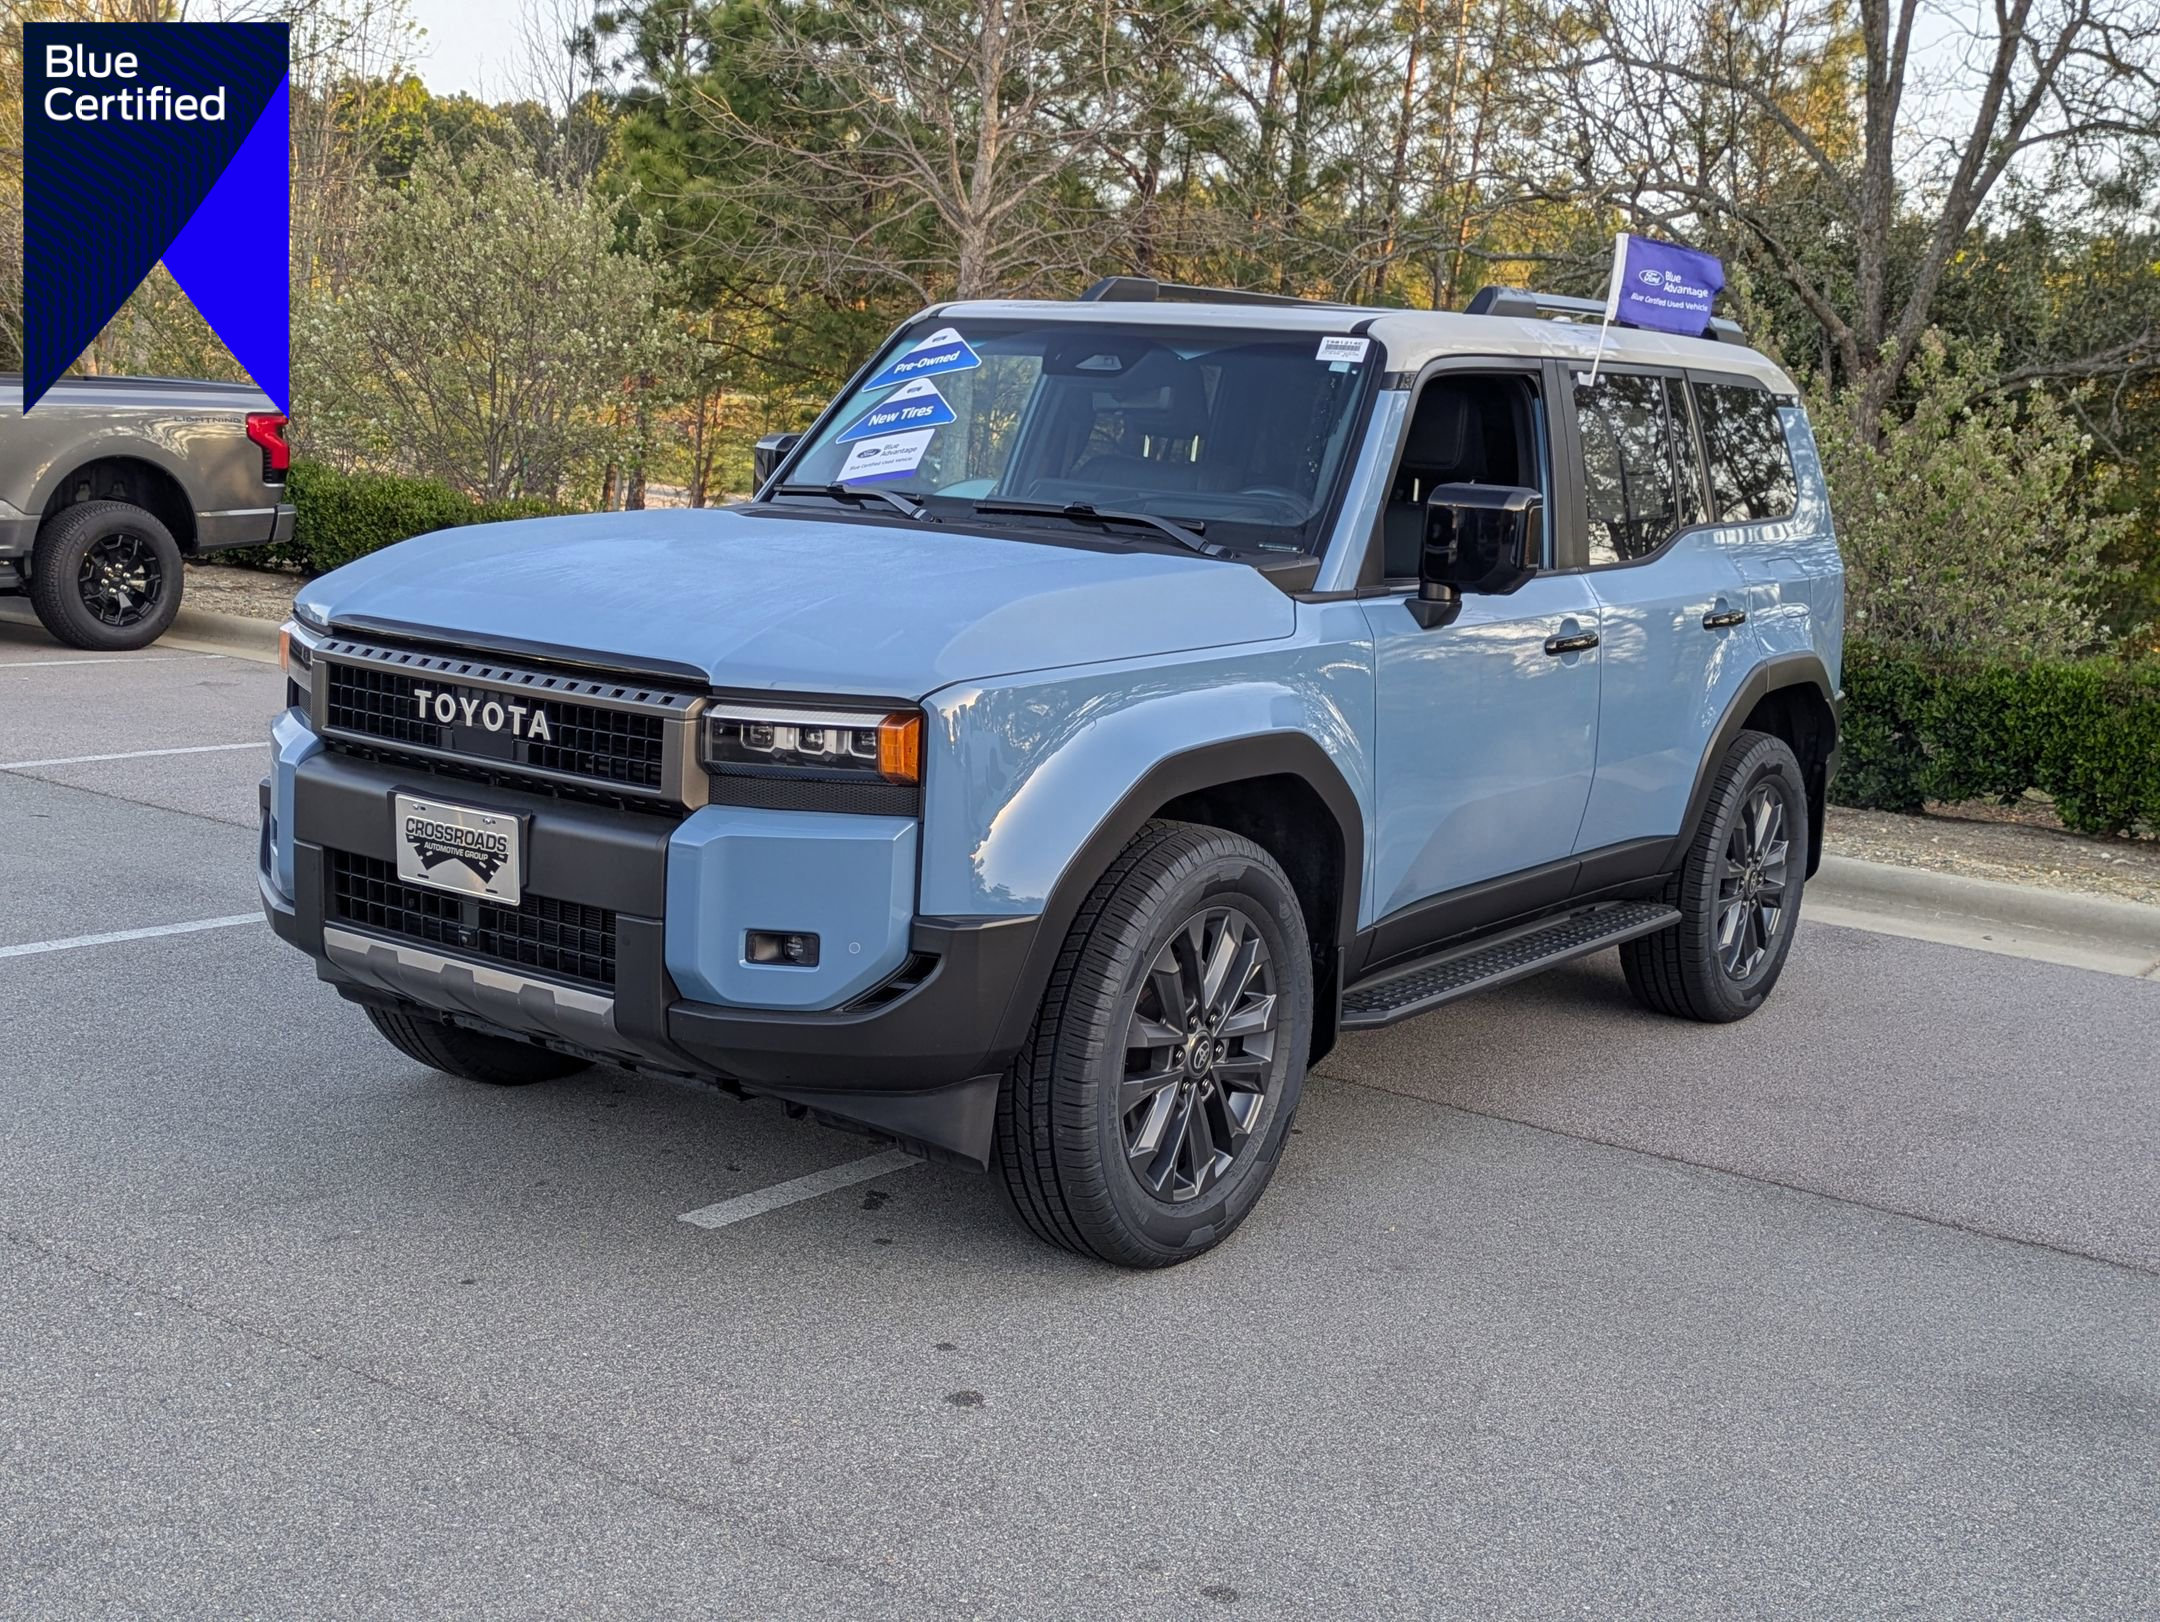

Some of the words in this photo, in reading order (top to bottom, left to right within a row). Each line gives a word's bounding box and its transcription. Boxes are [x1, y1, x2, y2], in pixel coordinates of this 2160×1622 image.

[1665, 270, 1682, 283] Blue
[1663, 282, 1708, 298] Advantage
[1630, 292, 1644, 302] Blue
[1667, 300, 1685, 309] Used
[1685, 301, 1708, 312] Vehicle
[894, 350, 961, 374] Pre-Owned
[174, 415, 242, 424] LIGHTNING
[868, 410, 899, 427] New
[901, 405, 935, 421] Tires
[414, 689, 551, 741] TOYOTA
[405, 815, 508, 854] CROSSROADS
[424, 841, 463, 857] AUTOMOTIVE
[464, 849, 488, 861] GROUP
